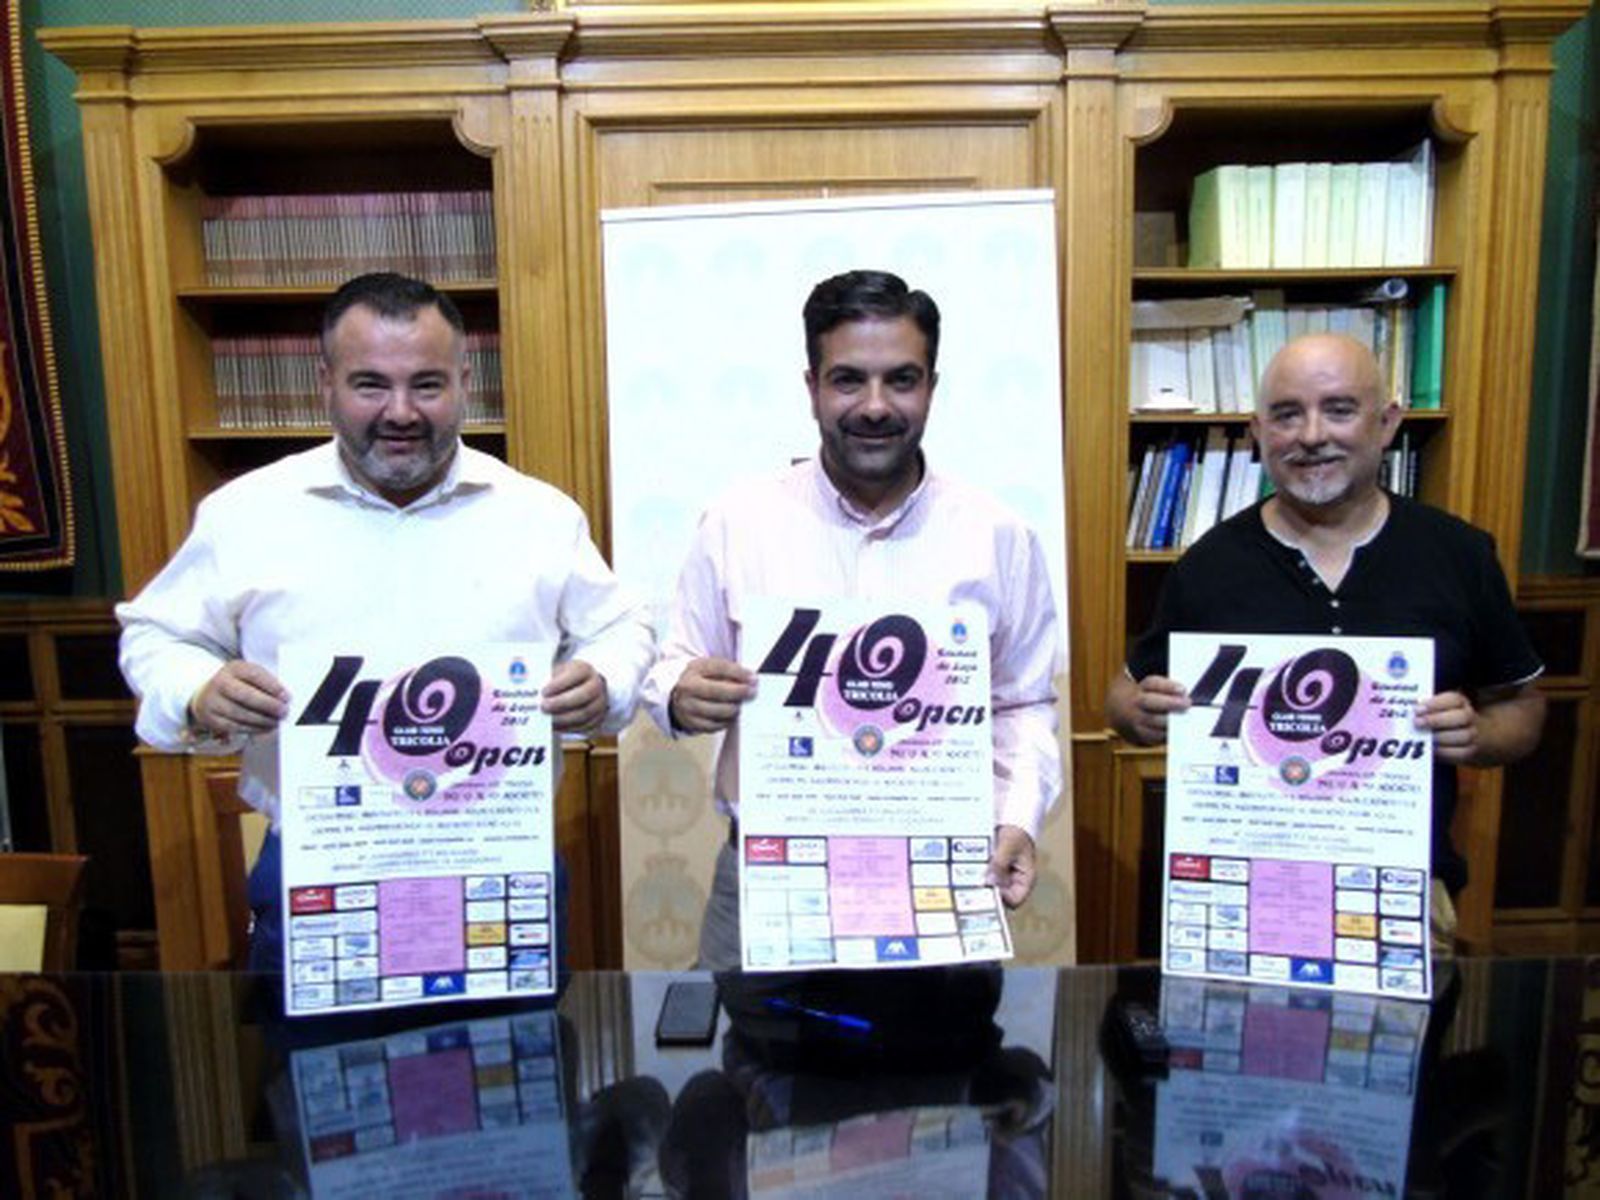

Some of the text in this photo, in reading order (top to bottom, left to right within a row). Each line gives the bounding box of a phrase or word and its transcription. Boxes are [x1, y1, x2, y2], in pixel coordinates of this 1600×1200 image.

[893, 697, 986, 731] Open
[444, 741, 545, 775] Open
[1319, 730, 1426, 764] Open
